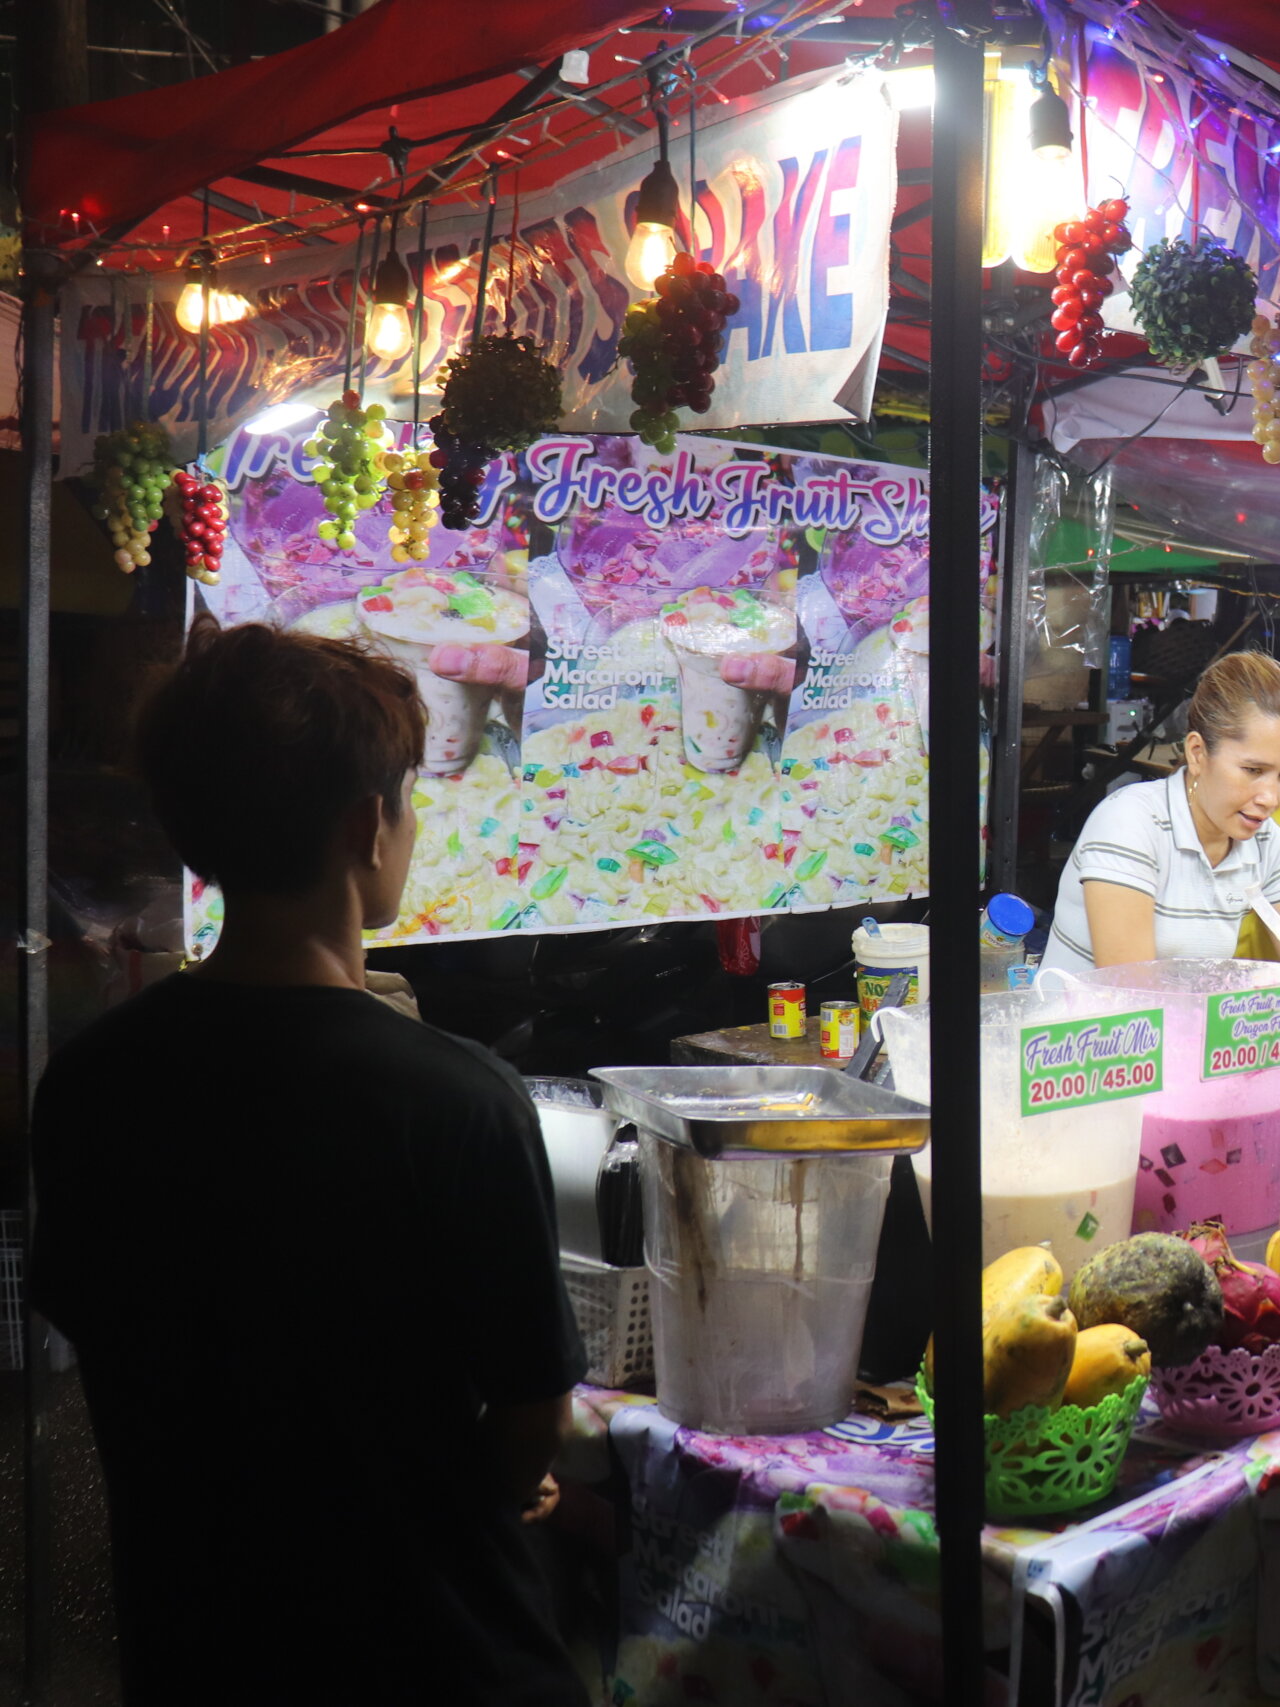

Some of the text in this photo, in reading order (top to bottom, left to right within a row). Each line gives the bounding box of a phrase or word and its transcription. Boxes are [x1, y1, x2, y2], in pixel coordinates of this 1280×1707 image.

[624, 134, 862, 374] HAKE
[527, 438, 709, 526] Fresh
[713, 463, 862, 535] Fruit
[545, 636, 623, 660] Street
[544, 660, 664, 686] Macaroni
[542, 686, 618, 710] Salad
[800, 687, 852, 711] Salad
[1221, 998, 1247, 1017] Fresh
[1233, 1019, 1269, 1038] Dragon
[1026, 1020, 1159, 1071] Fresh Fruit Mix
[1212, 1045, 1257, 1071] 20.00
[1031, 1075, 1085, 1103] 20.00
[1103, 1063, 1154, 1089] 45.00
[639, 1569, 711, 1641] Salad
